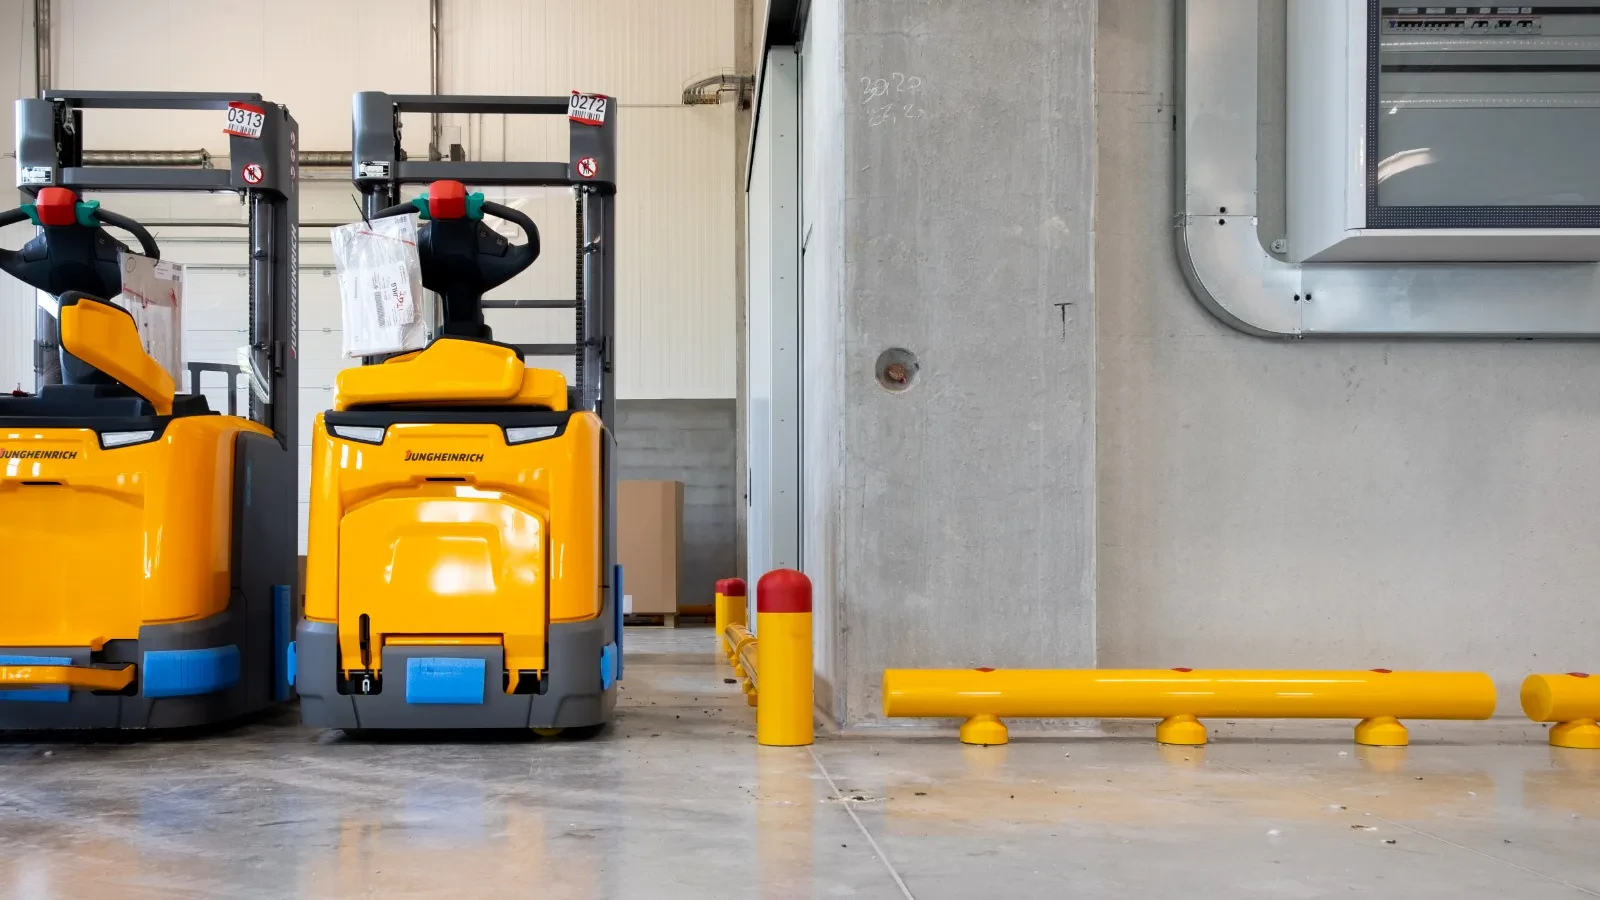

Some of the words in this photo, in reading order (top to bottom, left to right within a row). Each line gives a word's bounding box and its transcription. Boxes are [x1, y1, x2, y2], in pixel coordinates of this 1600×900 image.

[570, 94, 605, 113] 0272
[227, 107, 262, 128] 0313
[404, 449, 485, 463] JUNGHEINRICH
